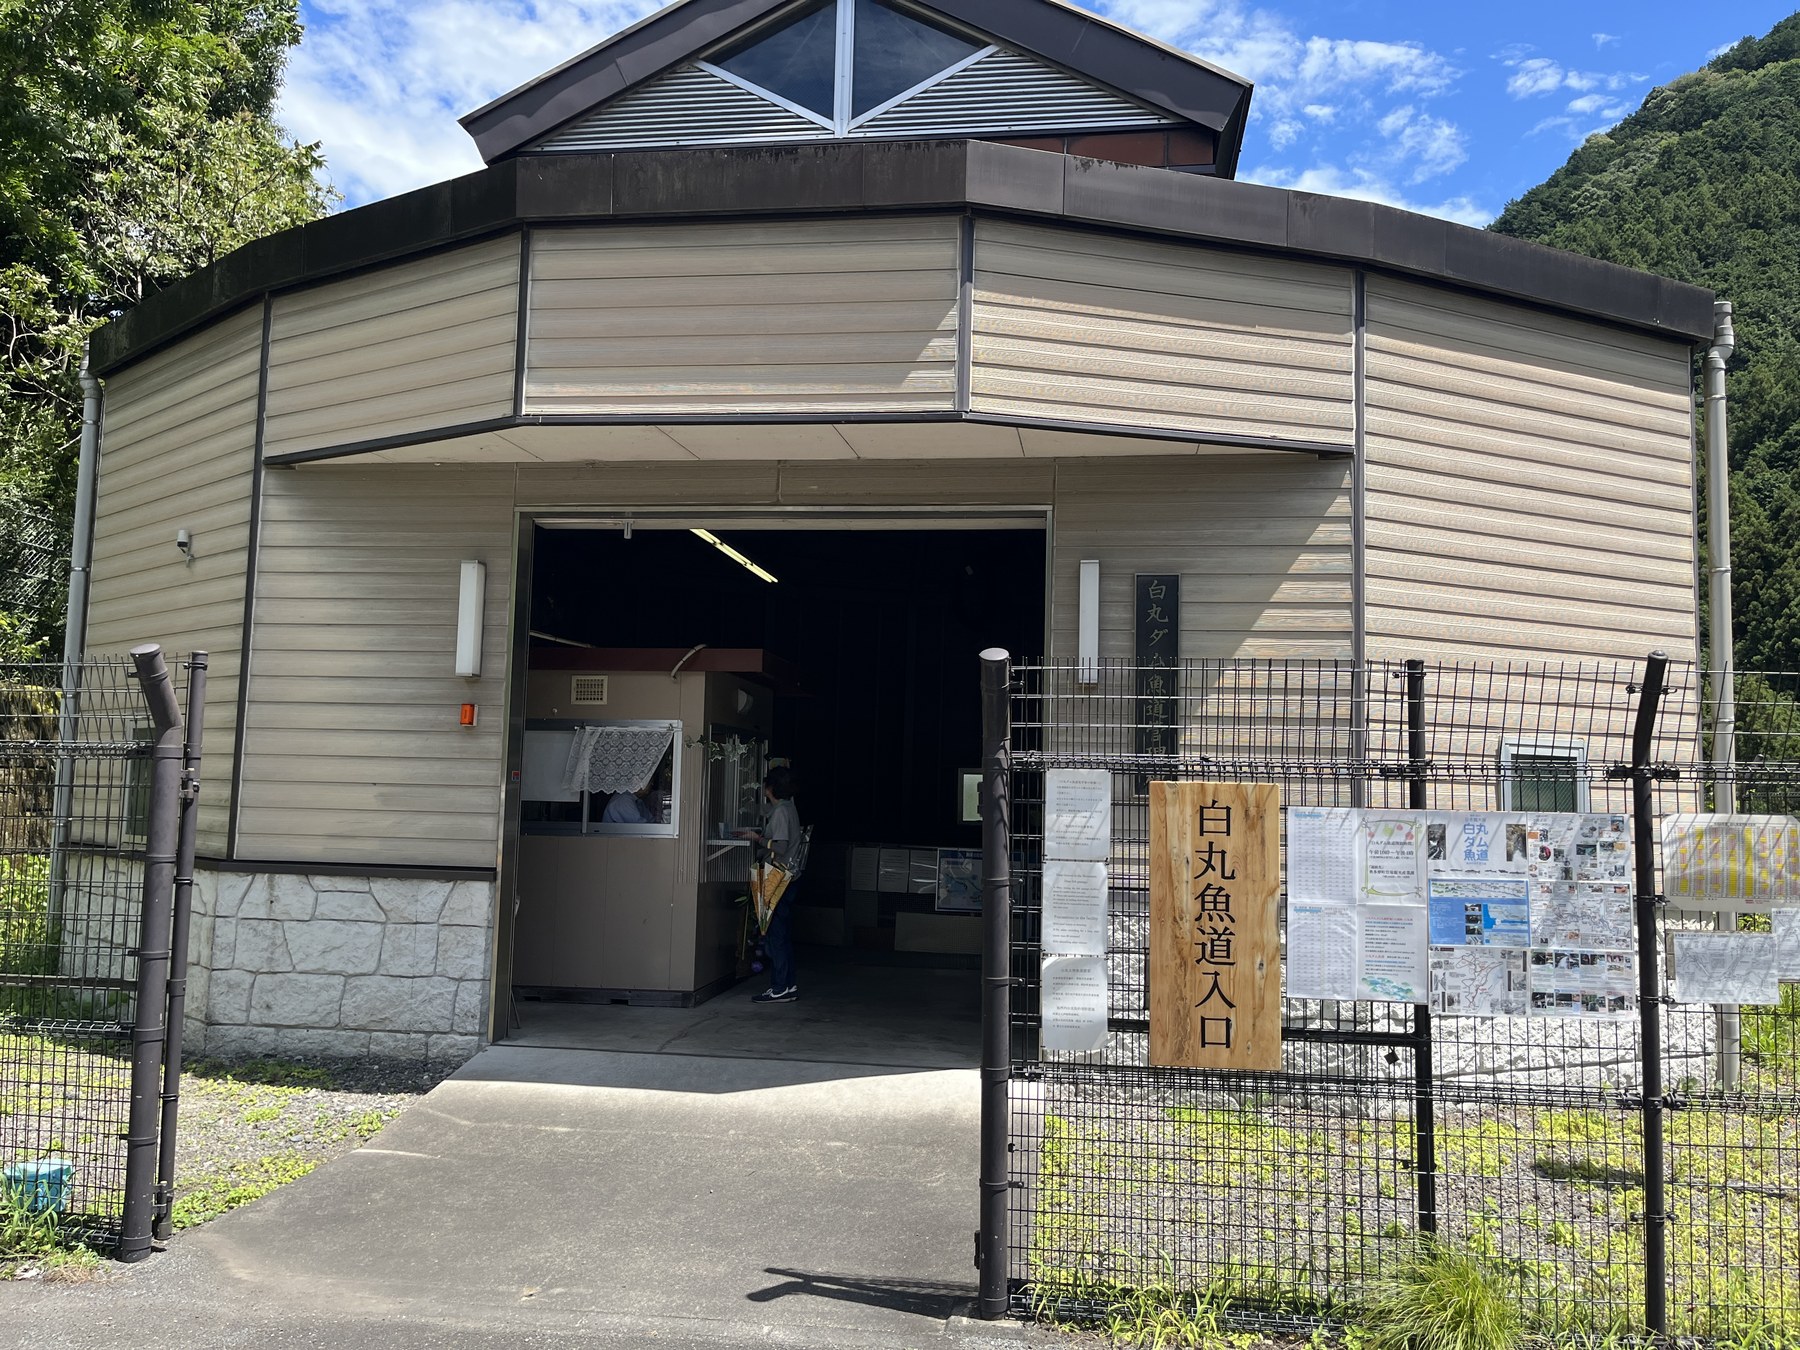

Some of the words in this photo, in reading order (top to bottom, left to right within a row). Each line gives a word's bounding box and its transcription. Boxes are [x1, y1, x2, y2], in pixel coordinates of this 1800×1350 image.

[1463, 823, 1488, 835] 白丸
[1464, 836, 1489, 848] ダム
[1463, 849, 1489, 861] 魚道
[1193, 799, 1236, 1049] 白丸魚道入口
